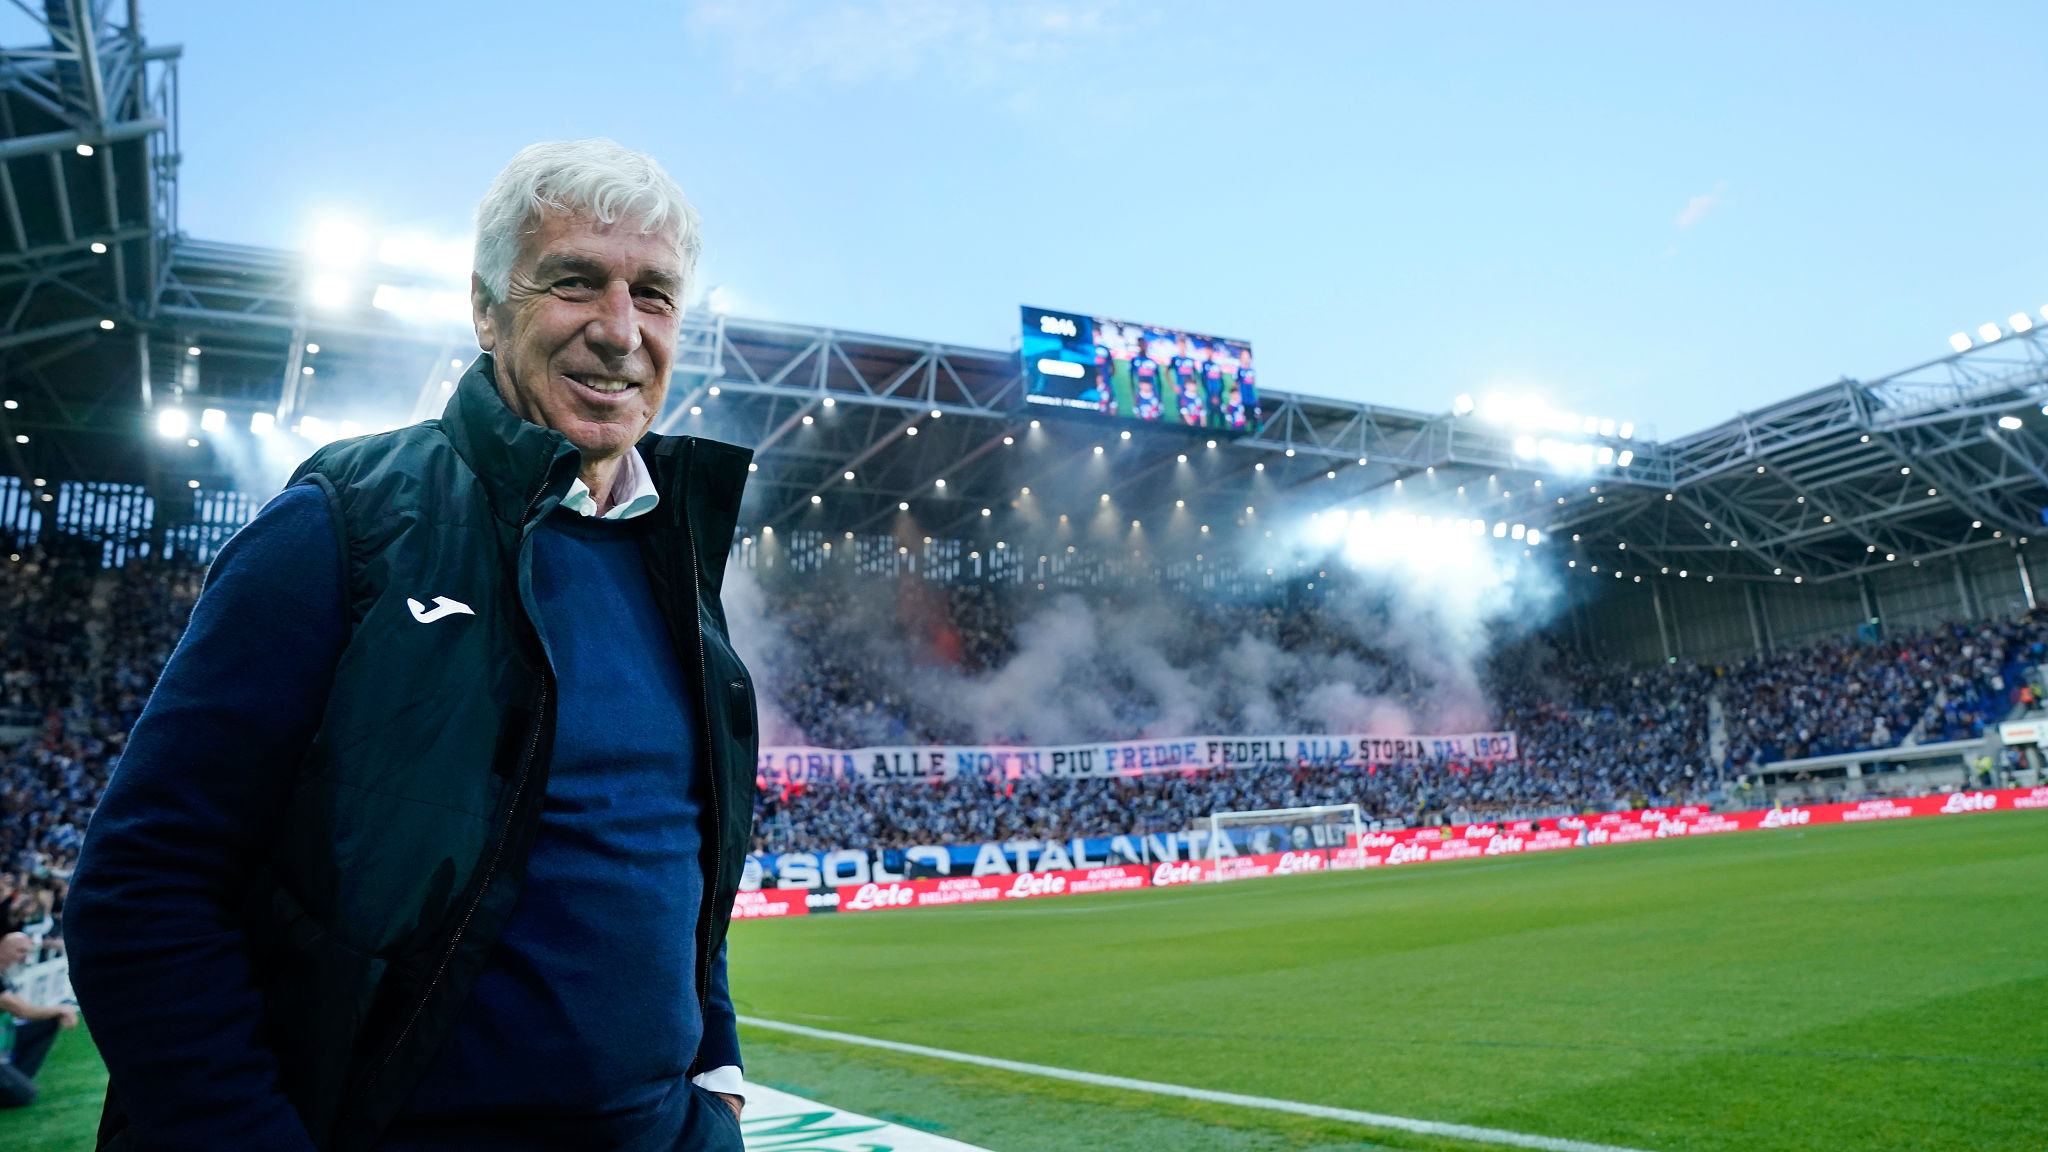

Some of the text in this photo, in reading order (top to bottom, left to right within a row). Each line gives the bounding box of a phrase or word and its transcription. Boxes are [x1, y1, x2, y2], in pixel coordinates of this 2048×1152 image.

[873, 753, 945, 778] ALLE
[1207, 741, 1286, 763] FEDELI
[1360, 738, 1425, 760] STORIA
[1473, 736, 1510, 757] 1907
[1940, 792, 1997, 813] Lete
[1758, 808, 1811, 828] Lete
[972, 829, 1238, 877] ATALANTA
[1273, 852, 1321, 875] Lete
[1385, 843, 1428, 865] Lete
[1005, 873, 1066, 898] Lete
[1153, 861, 1201, 886] Lete
[845, 883, 914, 910] Lete
